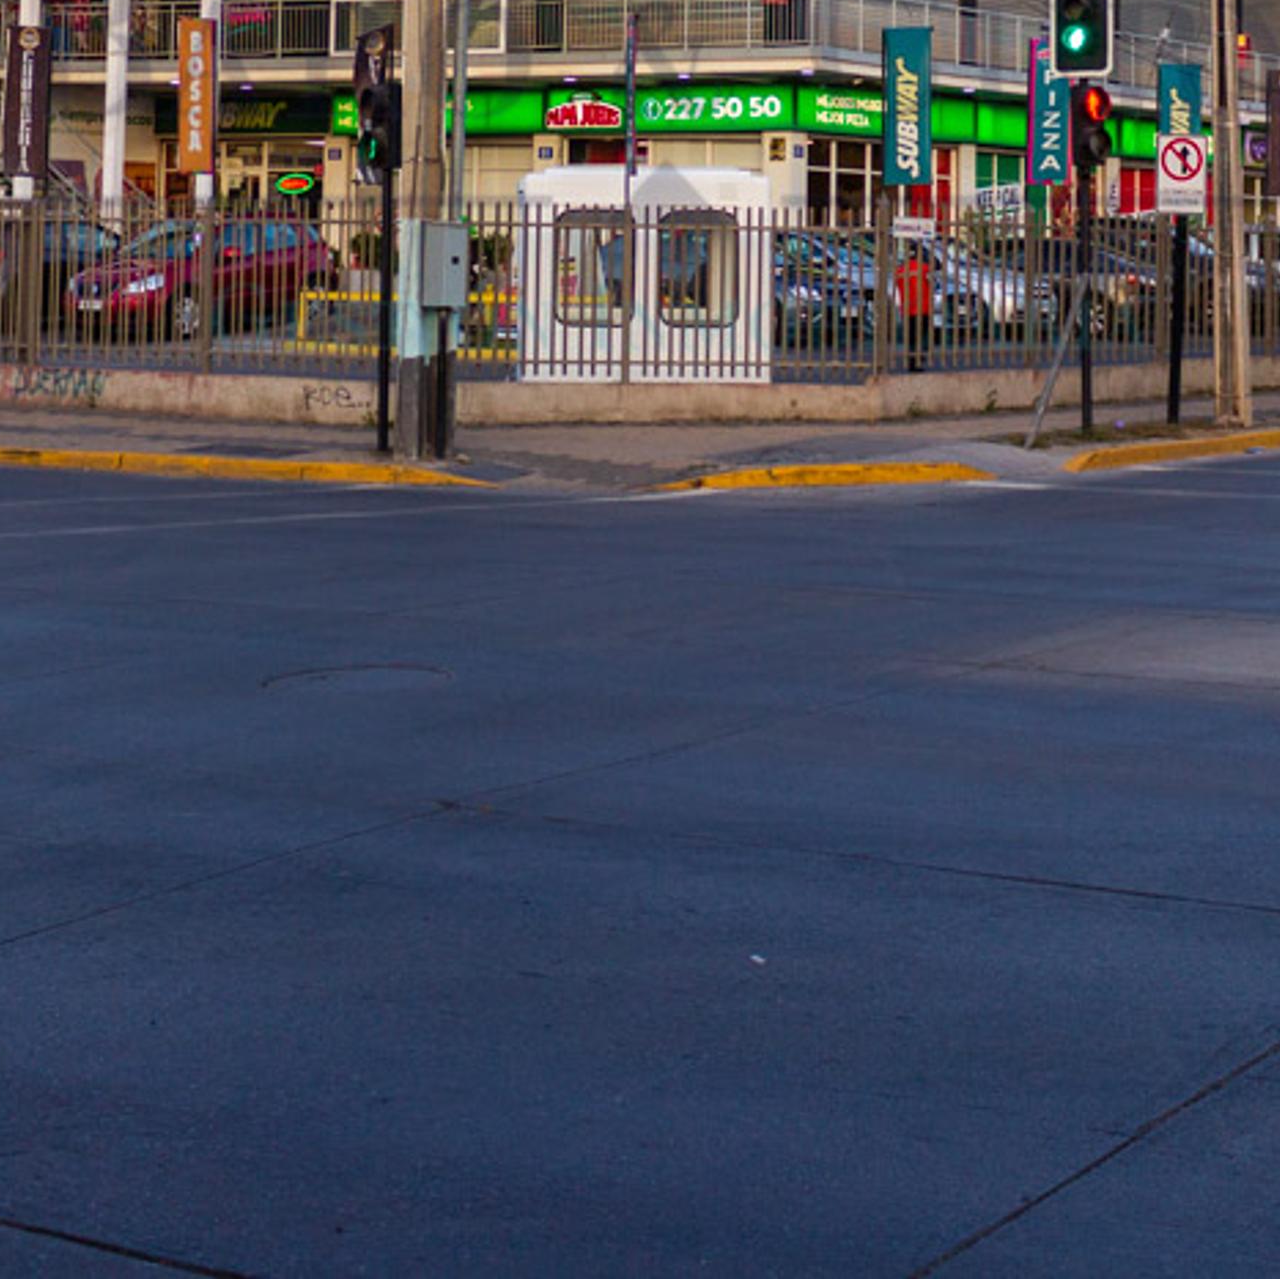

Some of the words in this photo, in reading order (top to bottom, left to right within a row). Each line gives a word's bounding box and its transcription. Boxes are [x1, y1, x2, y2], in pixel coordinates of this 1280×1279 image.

[187, 31, 204, 153] BOSCA
[220, 102, 288, 128] BWAY
[665, 100, 706, 119] 227
[711, 97, 743, 119] 50
[749, 96, 781, 117] 50
[895, 56, 920, 179] SUBWAY
